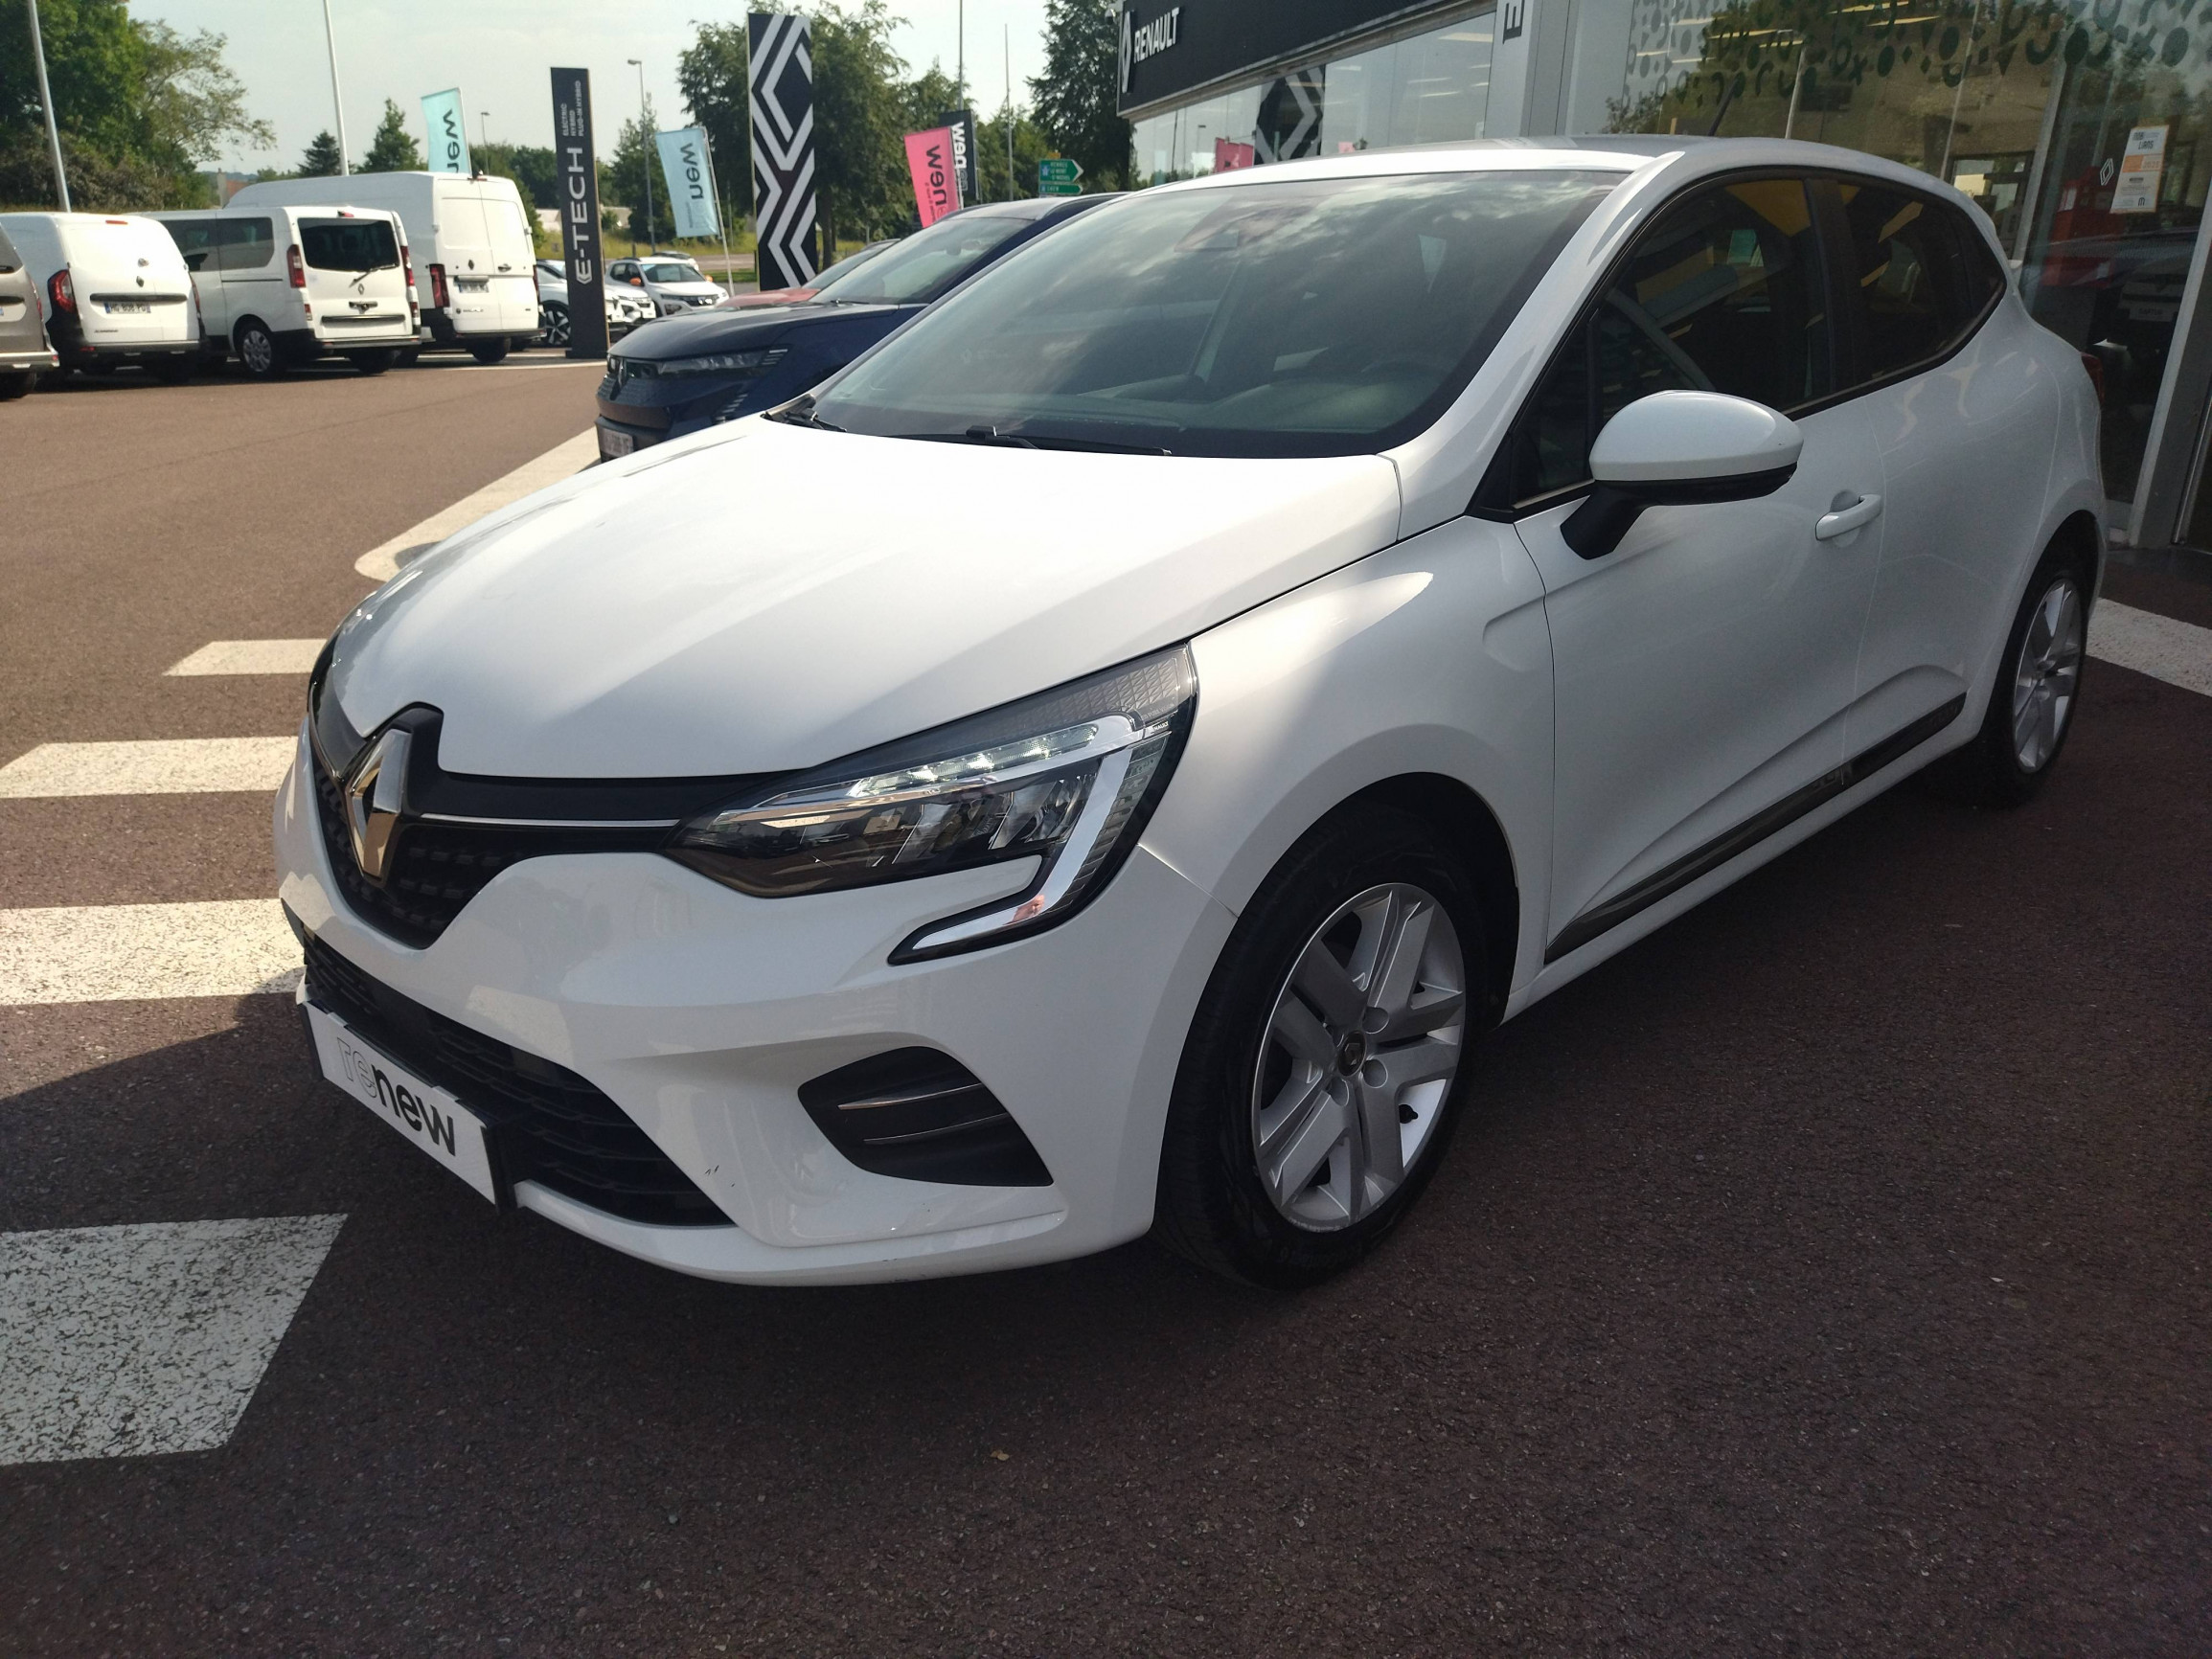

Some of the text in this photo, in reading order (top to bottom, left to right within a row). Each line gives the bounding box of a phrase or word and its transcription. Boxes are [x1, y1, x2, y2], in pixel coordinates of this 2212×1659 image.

[1134, 7, 1179, 64] RENAULT
[560, 102, 569, 137] ELECTRIC
[566, 147, 593, 284] E-TECH
[337, 1036, 456, 1157] renew
